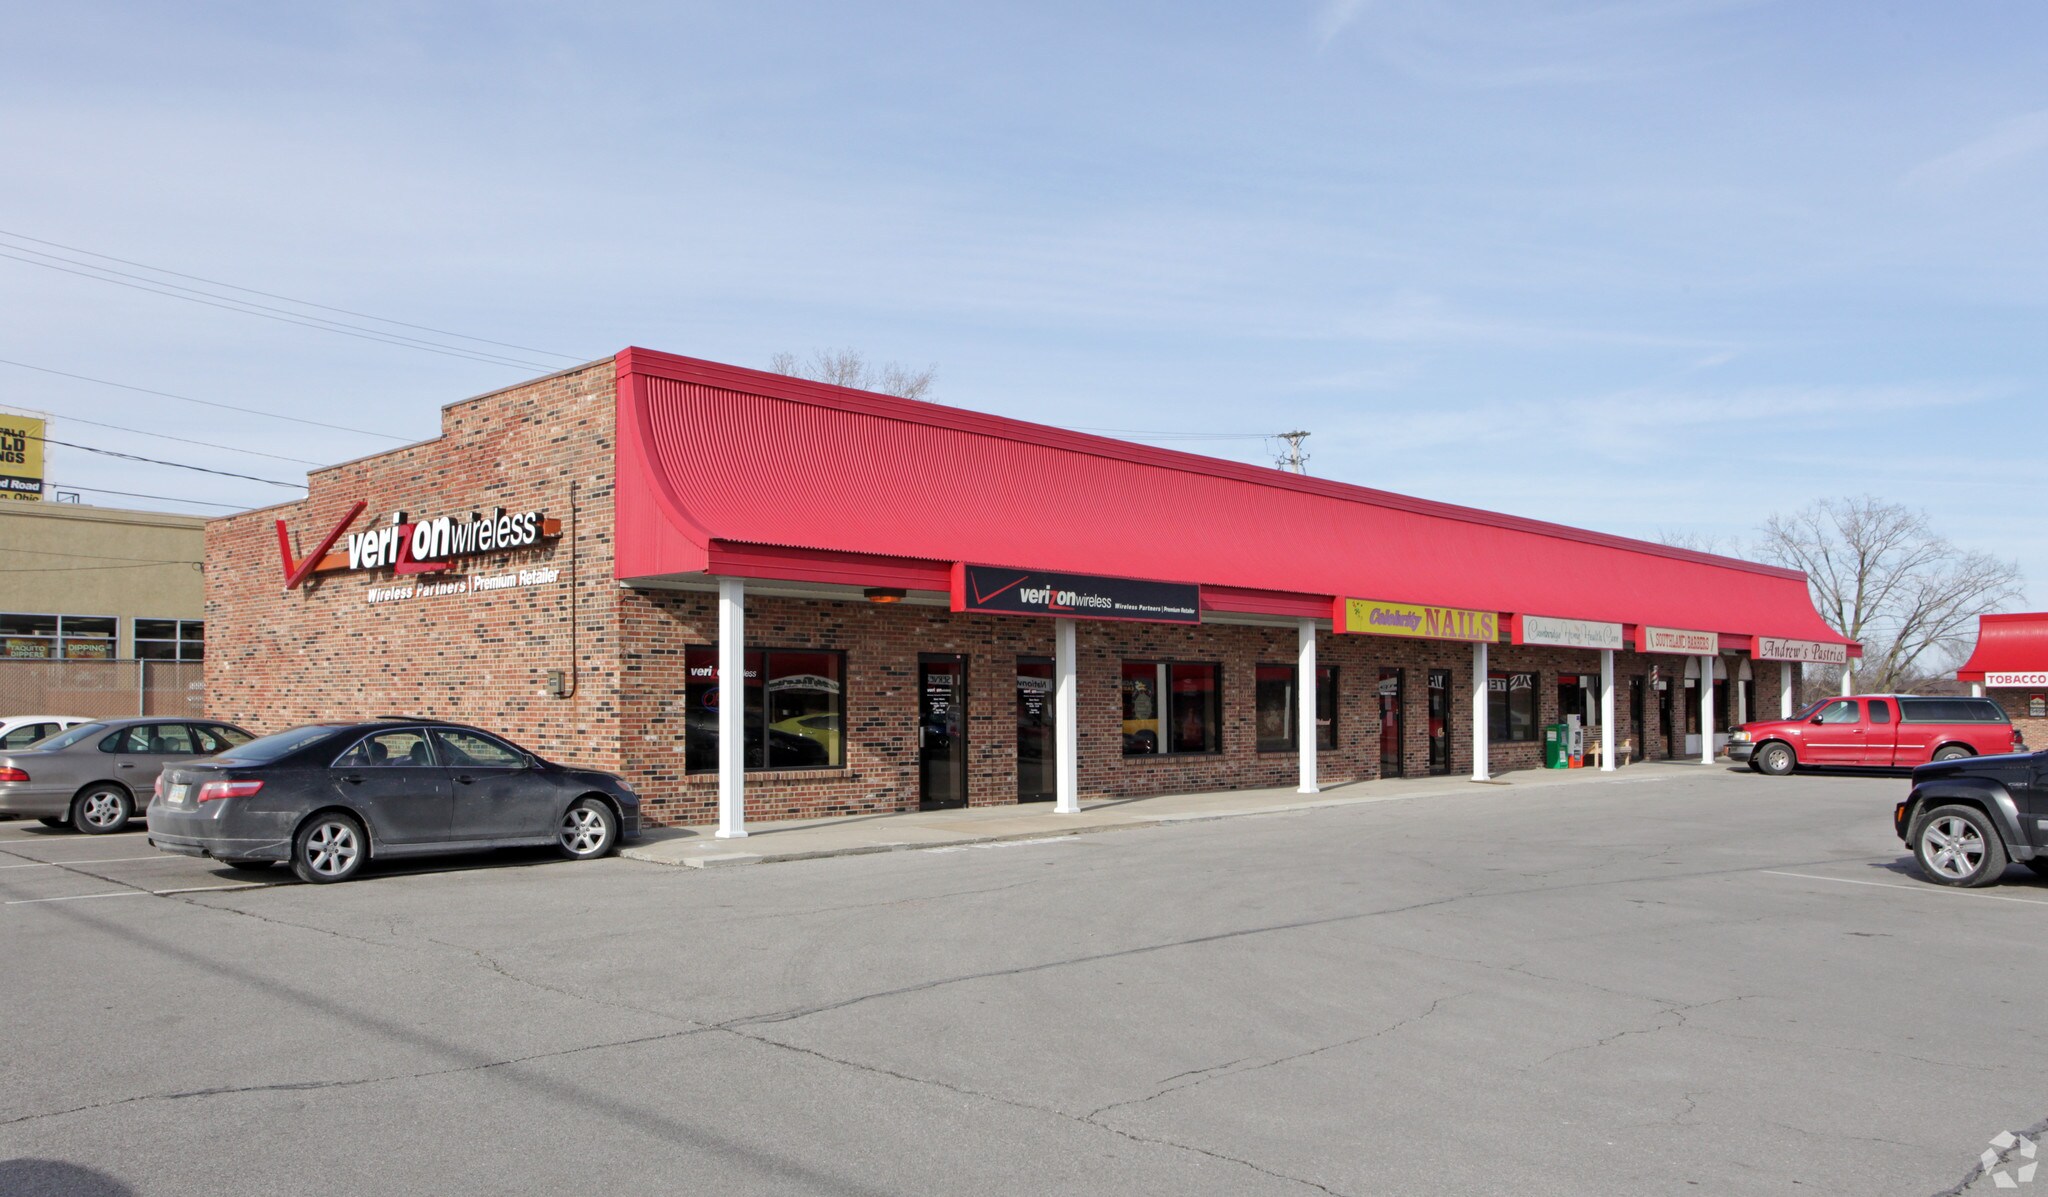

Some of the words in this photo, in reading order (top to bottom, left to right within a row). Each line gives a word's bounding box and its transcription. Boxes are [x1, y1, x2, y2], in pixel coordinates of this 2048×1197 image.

[10, 480, 40, 491] Road
[349, 511, 457, 575] verizon
[451, 508, 537, 554] wireless
[368, 585, 413, 602] Wireless
[416, 581, 467, 597] Partners
[474, 574, 518, 592] Premium
[519, 567, 560, 586] Retailer
[1020, 585, 1076, 611] verizon
[1076, 592, 1112, 609] wireless
[1114, 602, 1138, 611] Wireless
[1138, 604, 1161, 612] Partners
[1181, 607, 1196, 615] Retailer
[1369, 608, 1422, 632] Celebrity
[1424, 608, 1493, 640] NAILS
[1687, 635, 1709, 650] BARBERS
[1762, 639, 1808, 660] Andrew's
[1812, 643, 1845, 662] Pastries
[690, 665, 719, 679] veriz
[1988, 675, 2046, 684] TOBACCO
